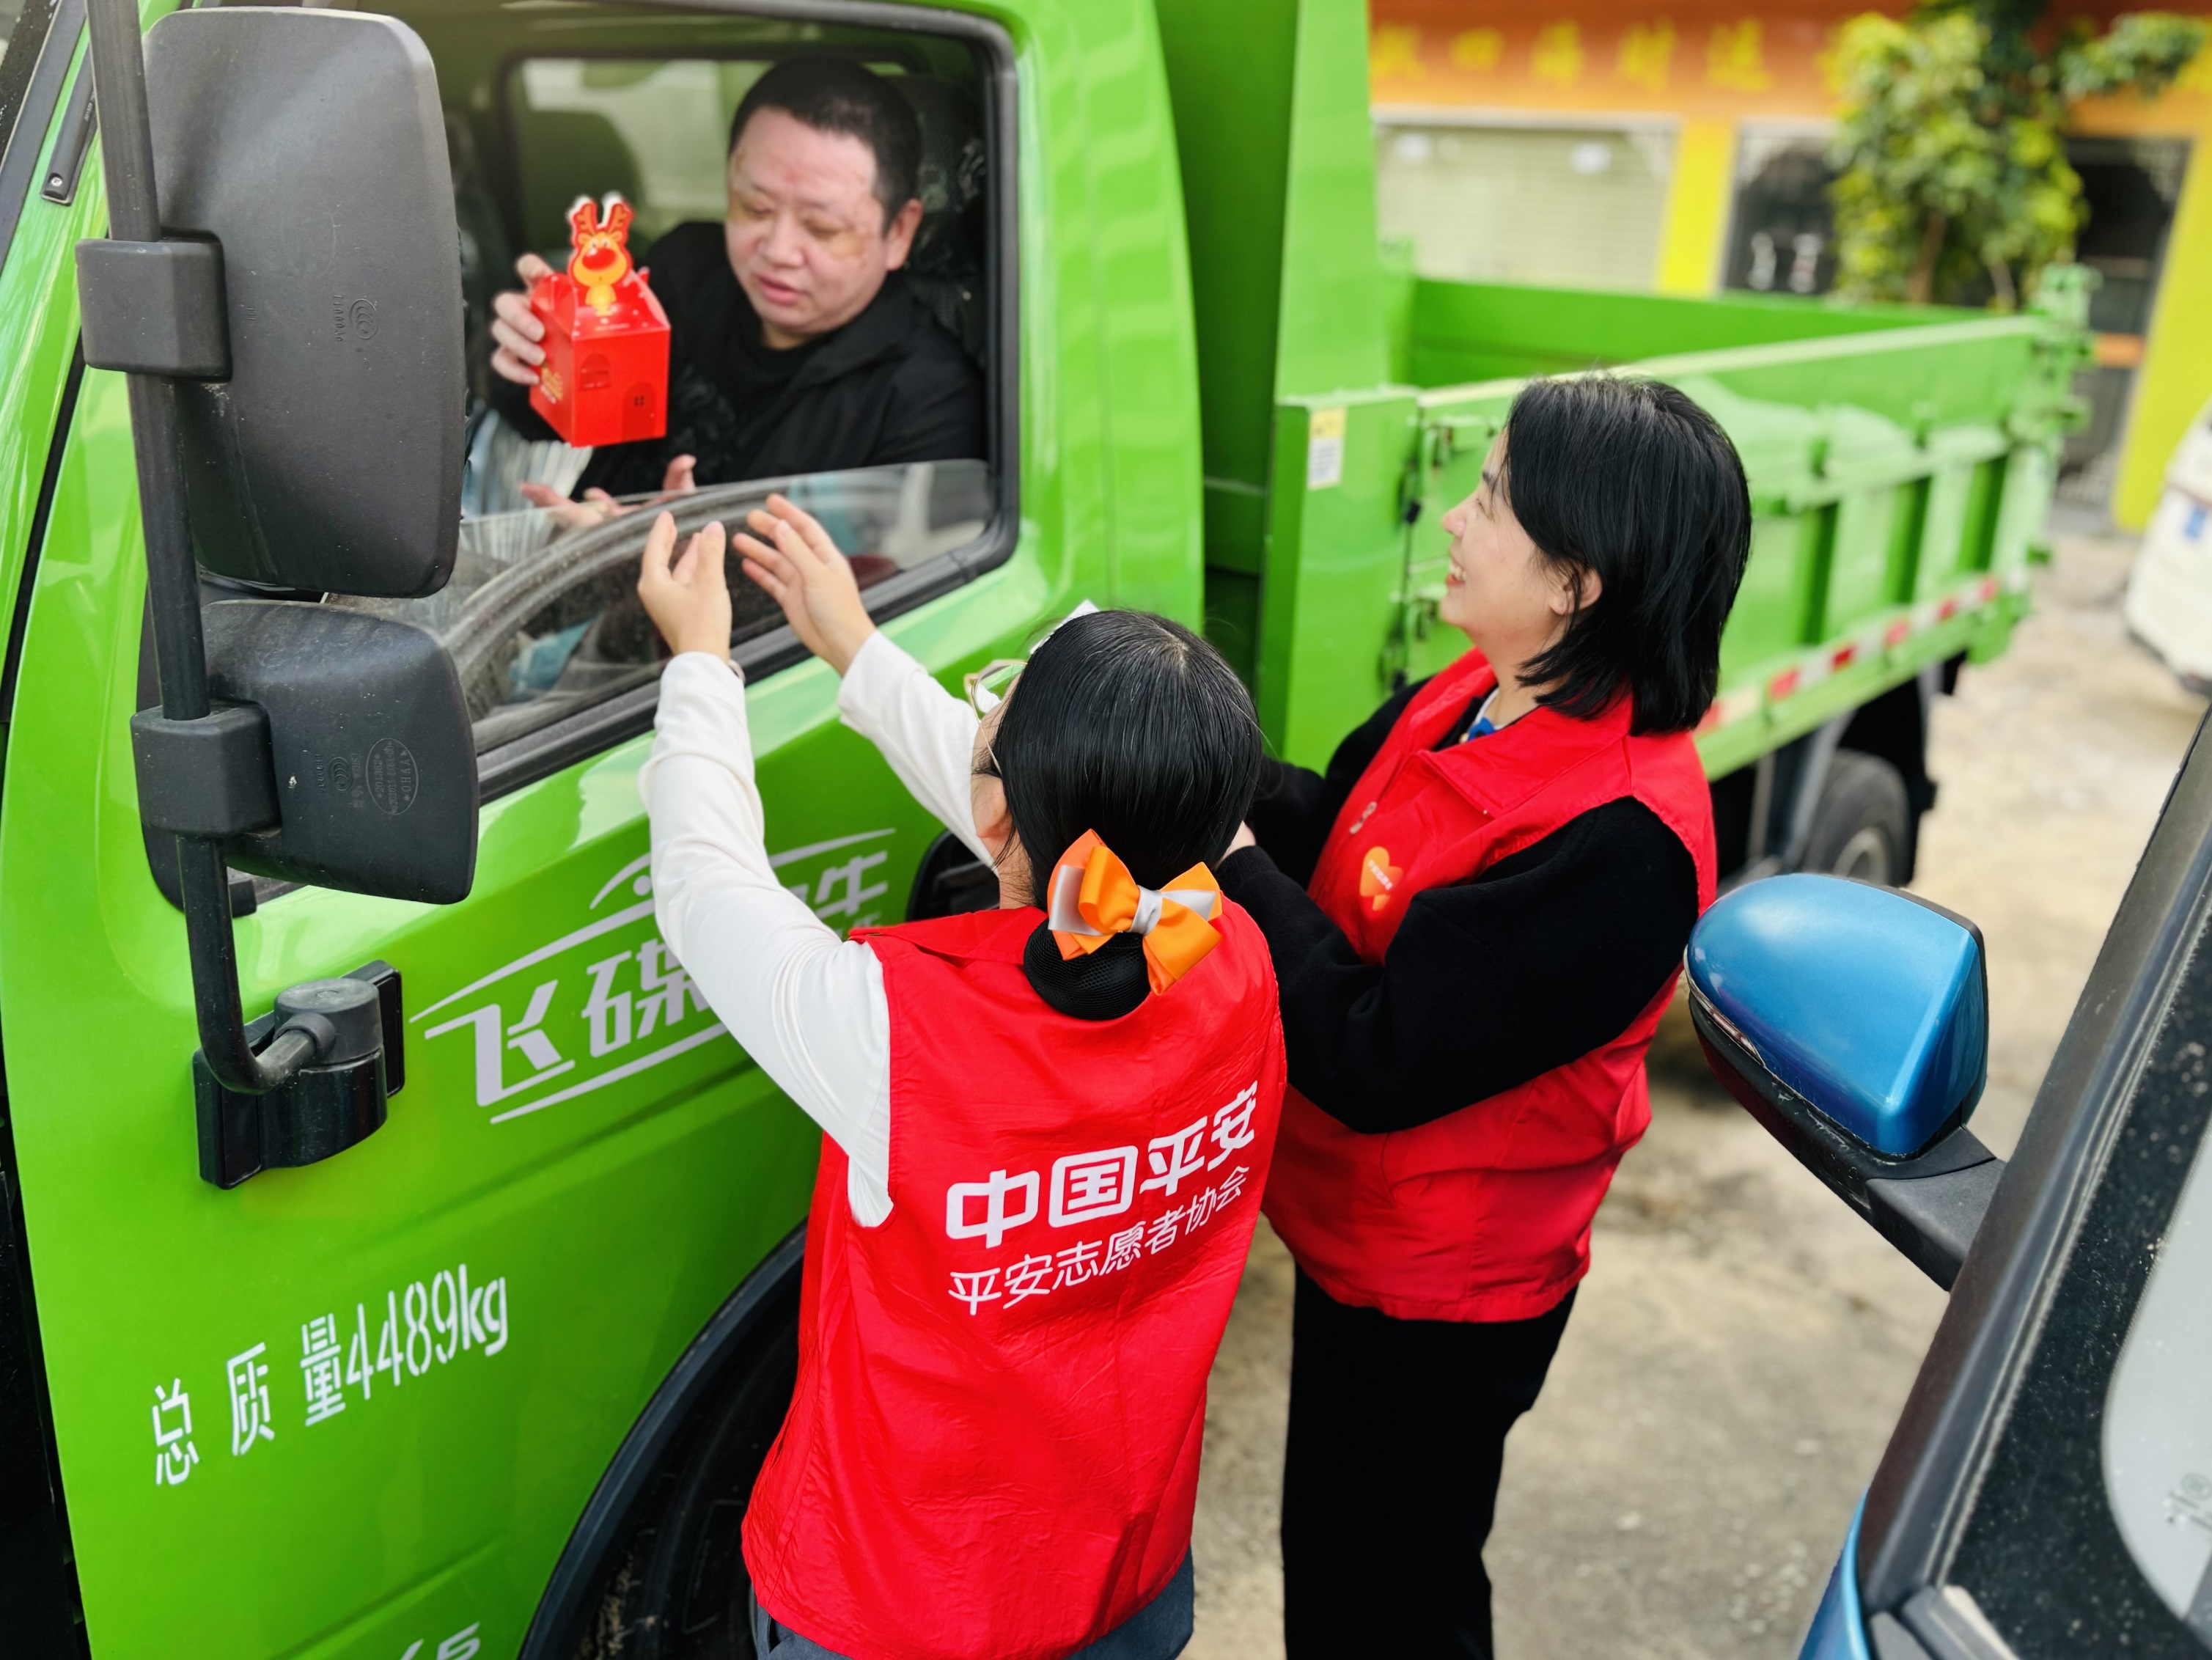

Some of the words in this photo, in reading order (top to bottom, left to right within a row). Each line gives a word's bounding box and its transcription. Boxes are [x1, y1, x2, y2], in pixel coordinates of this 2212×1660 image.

[947, 1080, 1258, 1249] 中国平安
[948, 1166, 1250, 1316] 平安志愿者协会
